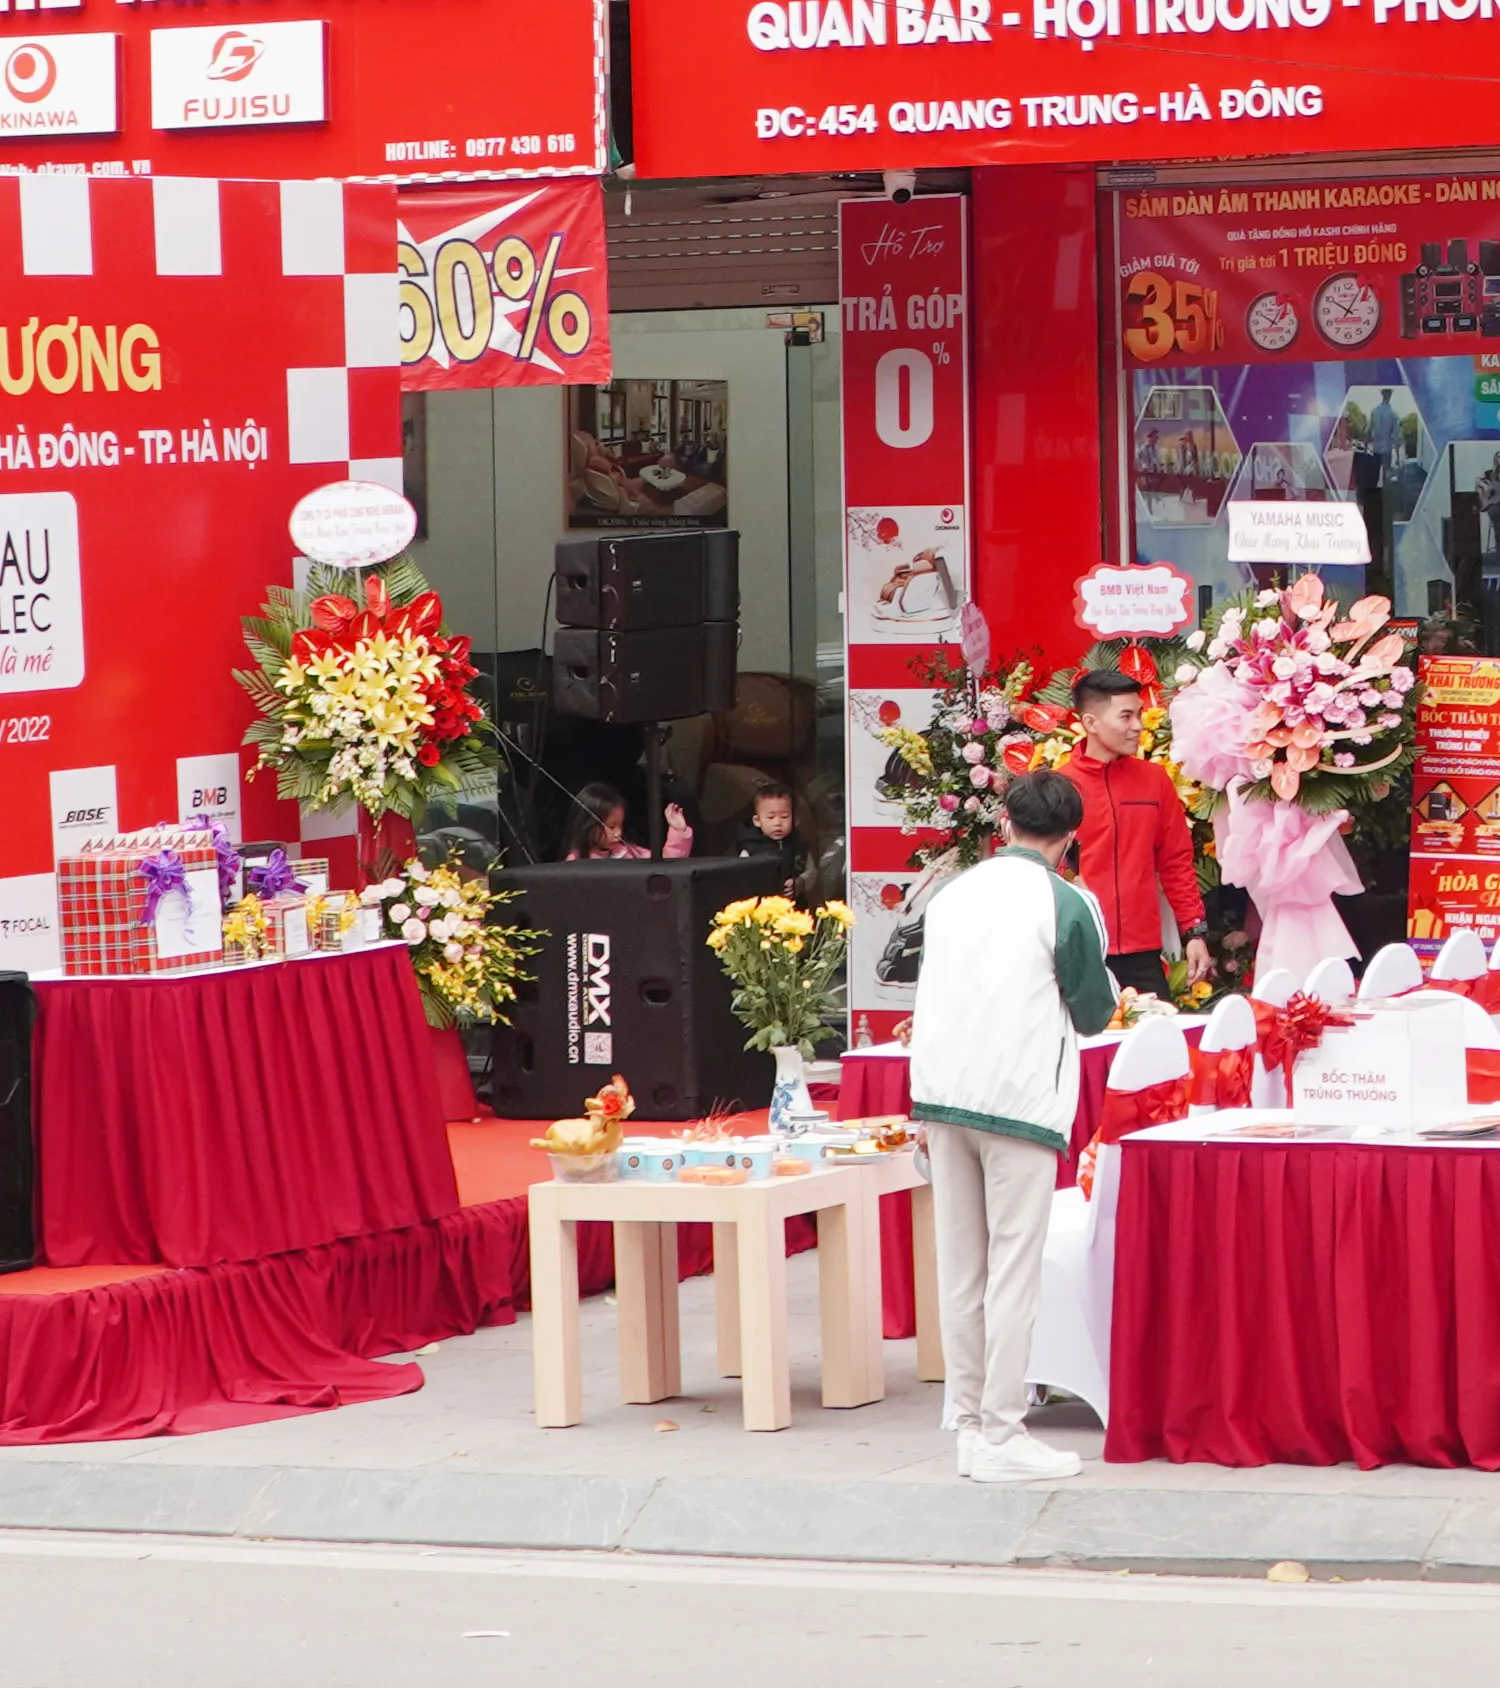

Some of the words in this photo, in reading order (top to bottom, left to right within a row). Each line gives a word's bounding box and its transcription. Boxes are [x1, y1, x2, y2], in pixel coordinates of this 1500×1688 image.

[182, 93, 293, 123] FUJISU
[888, 95, 1011, 137] QUANG
[1219, 78, 1323, 121] ĐÔNG
[384, 138, 458, 162] HOTLINE:
[465, 135, 507, 158] 0977
[511, 134, 541, 156] 430
[546, 132, 576, 154] 616
[841, 284, 899, 333] TRẢ
[905, 284, 963, 330] GÓP
[38, 422, 119, 471] ĐÔNG
[137, 425, 177, 466] TP.
[181, 420, 217, 464] HÀ
[223, 416, 268, 466] NỘI
